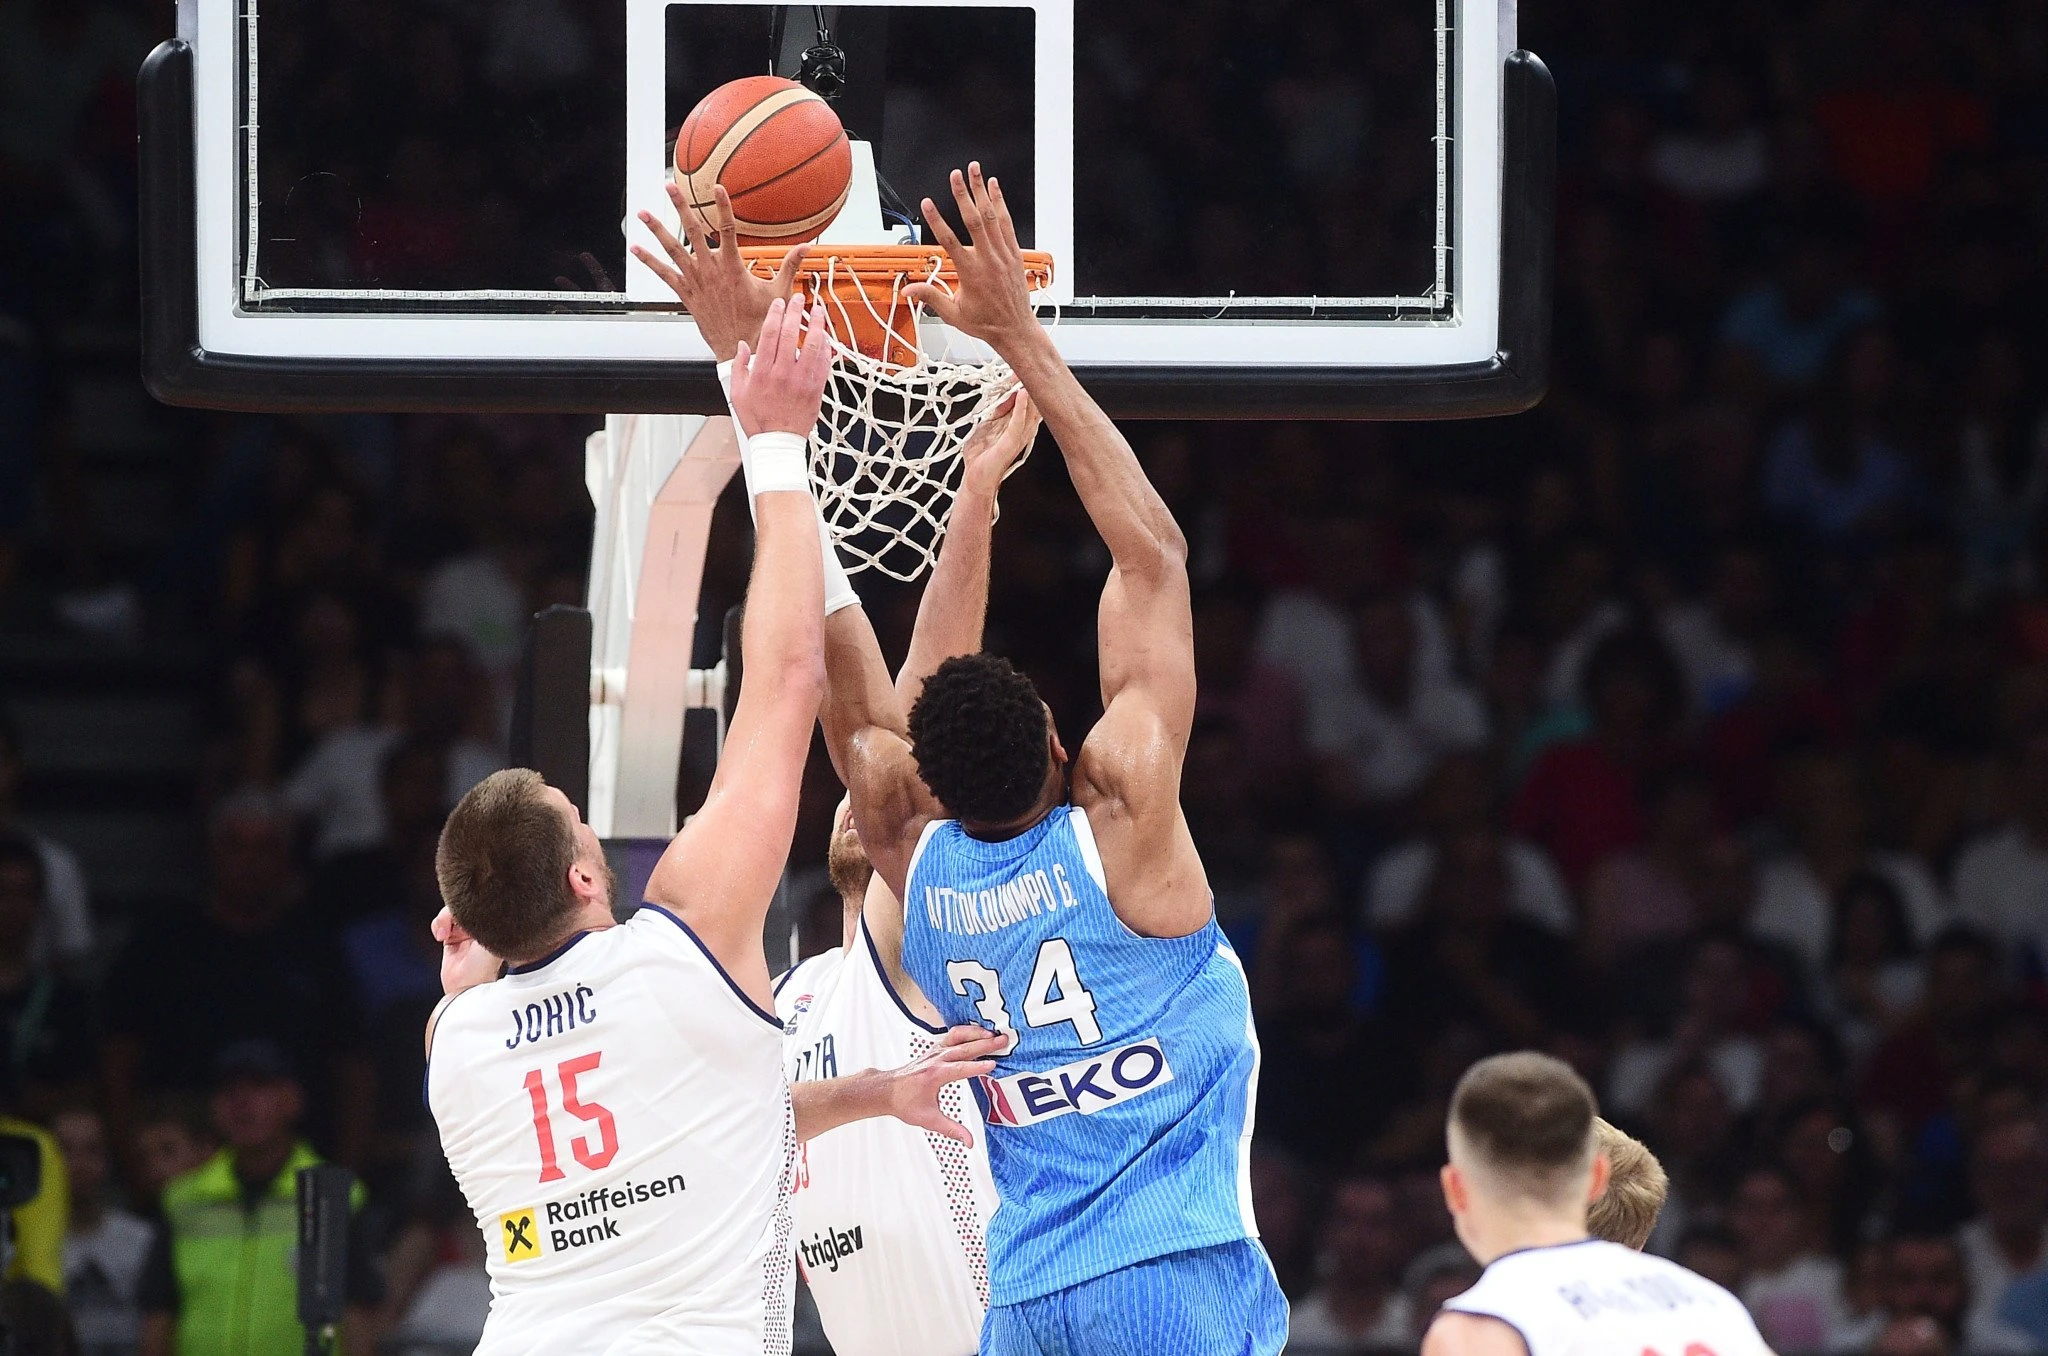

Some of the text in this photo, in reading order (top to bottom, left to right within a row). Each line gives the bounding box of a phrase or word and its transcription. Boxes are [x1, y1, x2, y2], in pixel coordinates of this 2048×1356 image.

[1052, 863, 1078, 908] G.
[946, 937, 1103, 1057] 34
[1017, 1044, 1163, 1117] EKO
[523, 1051, 619, 1183] 15
[546, 1173, 686, 1225] Raiffeisen
[551, 1215, 620, 1252] Bank
[800, 1225, 863, 1272] triglav
